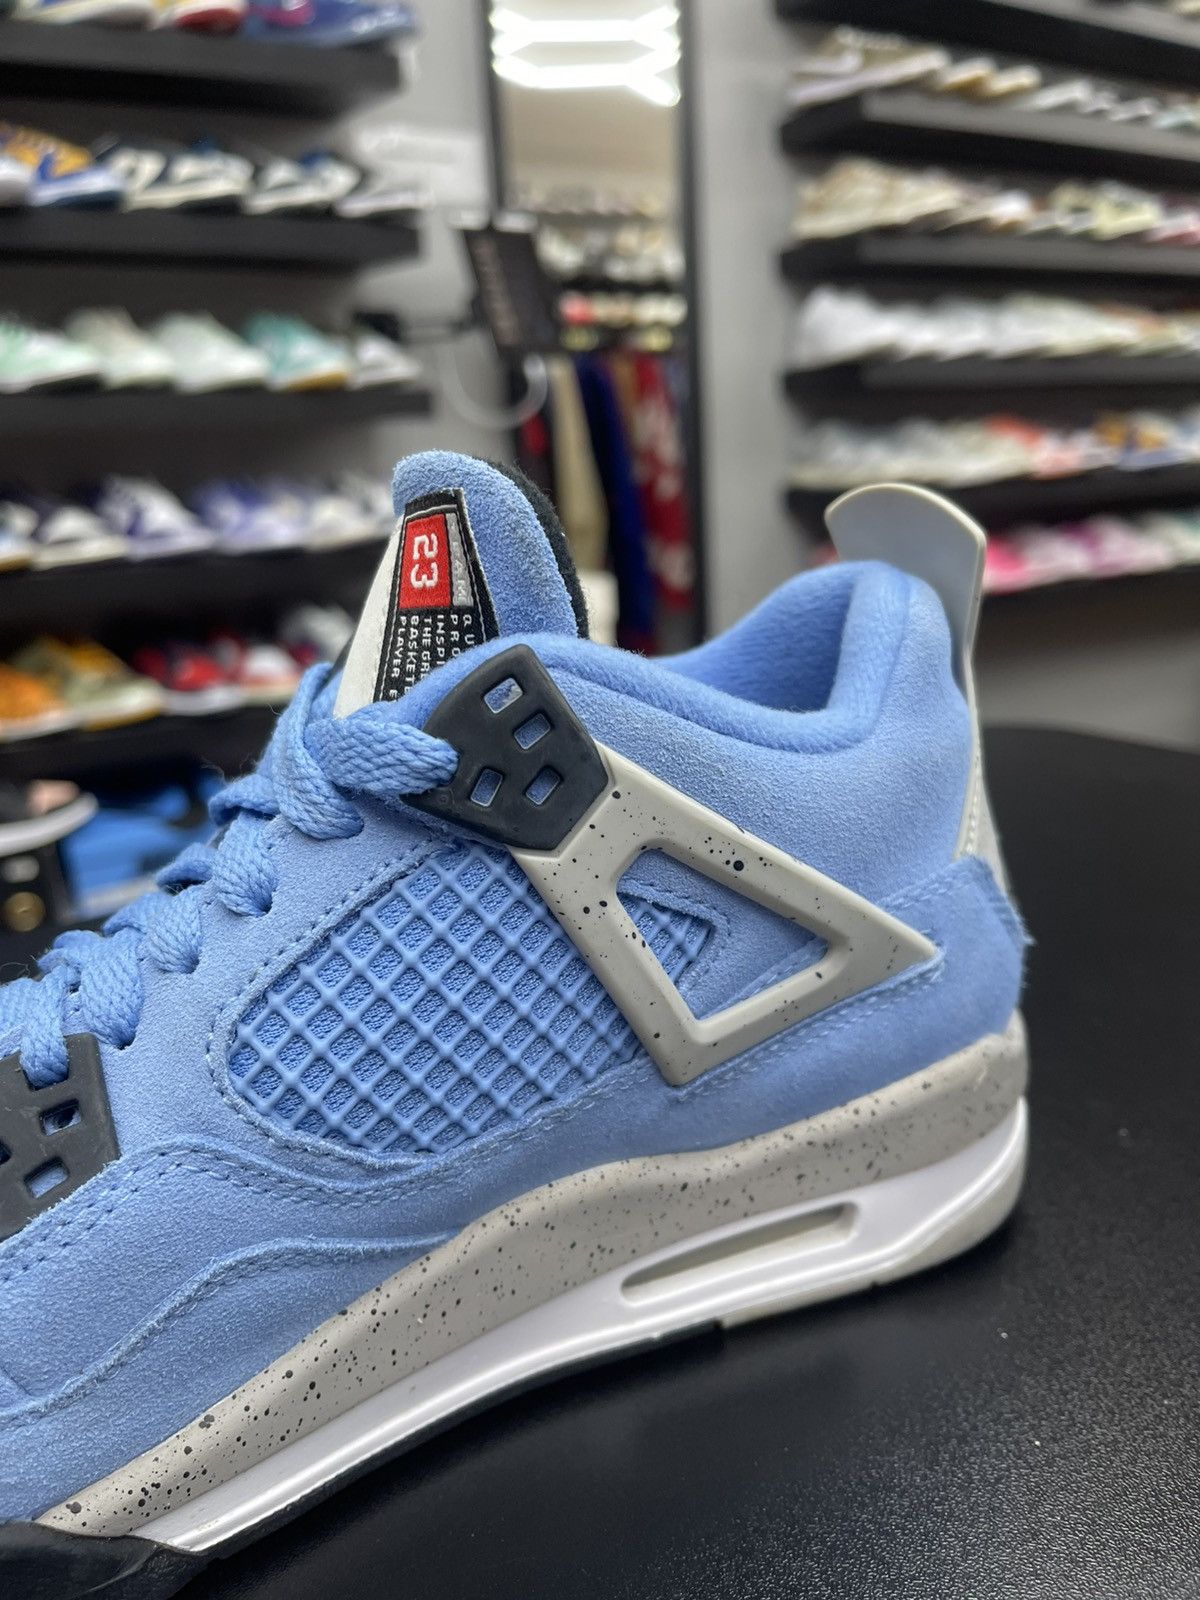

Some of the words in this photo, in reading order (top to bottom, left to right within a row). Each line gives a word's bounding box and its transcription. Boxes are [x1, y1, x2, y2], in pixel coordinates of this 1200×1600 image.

[410, 533, 438, 588] 23
[391, 616, 407, 677] PLAYER
[422, 616, 432, 648] THE
[450, 614, 461, 657] PRO
